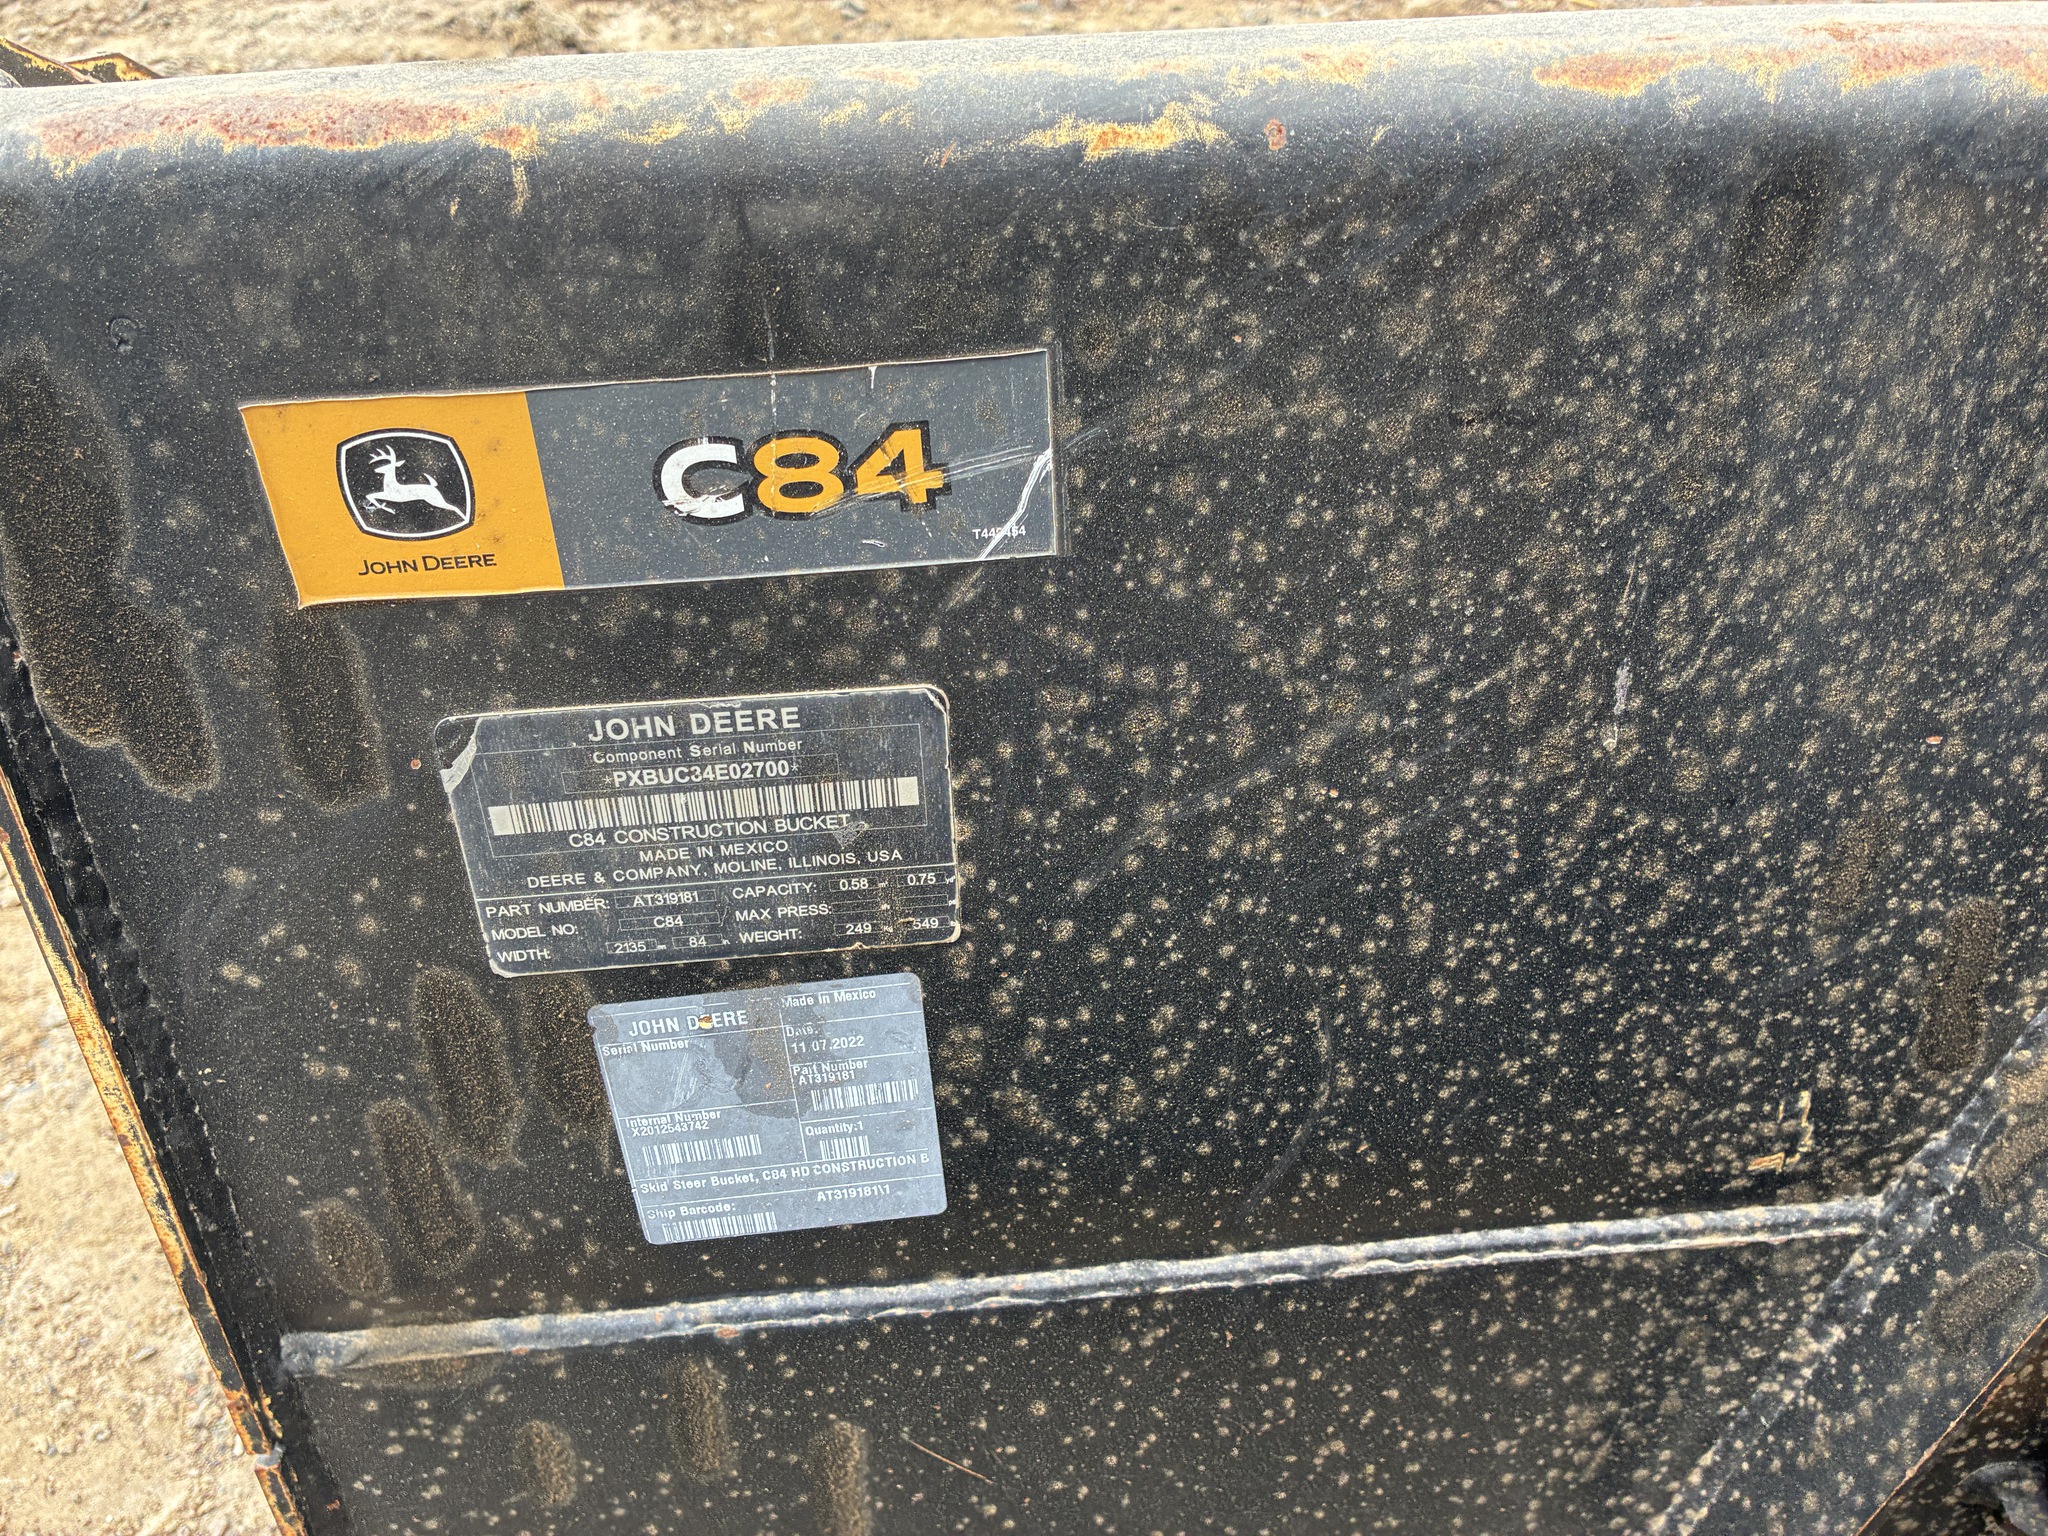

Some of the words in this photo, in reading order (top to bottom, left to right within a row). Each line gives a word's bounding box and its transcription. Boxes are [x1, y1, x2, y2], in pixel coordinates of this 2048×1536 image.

[655, 422, 950, 524] C84
[358, 559, 418, 576] JOHN
[422, 553, 497, 571] DEERE
[588, 715, 676, 742] JOHN
[689, 706, 801, 735] DEERE
[593, 747, 682, 764] Component
[689, 742, 736, 758] Serial
[743, 740, 803, 754] Number
[569, 832, 606, 848] C84
[613, 820, 768, 845] CONSTRUCTION
[775, 814, 851, 833] BUCKET
[639, 847, 690, 863] MADE
[697, 844, 714, 858] IN
[721, 840, 789, 856] MEXICO
[527, 873, 587, 889] DEERE
[594, 872, 606, 884] &
[613, 864, 708, 882] COMPANY,
[714, 857, 782, 874] MOLINE,
[789, 852, 861, 869] ILLINOIS,
[867, 850, 903, 863] USA
[732, 882, 818, 899] CAPACITY:
[839, 878, 869, 891] 0.58
[907, 873, 936, 885] 0.75
[485, 903, 531, 918] PART
[538, 898, 610, 914] NUMBER:
[633, 891, 700, 908] AT319181
[735, 909, 772, 922] MAX
[777, 904, 832, 919] PRESS:
[491, 927, 546, 941] MODEL
[552, 923, 579, 936] NO:
[653, 916, 684, 929] C84
[739, 928, 803, 944] WEIGHT:
[845, 923, 872, 935] 249
[913, 918, 939, 930] 549
[497, 948, 552, 963] WIDTH:
[614, 941, 647, 954] 2135
[689, 935, 707, 947] 84
[782, 996, 814, 1008] Made
[834, 989, 877, 1002] Mexico
[628, 1017, 680, 1037] JOHN
[687, 1010, 749, 1030] DERE
[602, 1044, 637, 1057] Serial
[641, 1038, 690, 1053] Number
[799, 1070, 855, 1085] AT319181
[822, 1060, 868, 1073] Number
[626, 1114, 671, 1128] Internal
[674, 1110, 721, 1123] Number
[631, 1120, 709, 1137] X2012543742
[640, 1182, 668, 1194] Skid
[673, 1179, 706, 1190] Steer
[711, 1173, 759, 1187] Bucket,
[762, 1169, 787, 1181] C84
[791, 1166, 810, 1177] HD
[813, 1155, 916, 1175] CONSTRUCTION
[920, 1153, 930, 1164] B
[647, 1208, 676, 1220] Ship
[680, 1202, 736, 1216] Barcode:
